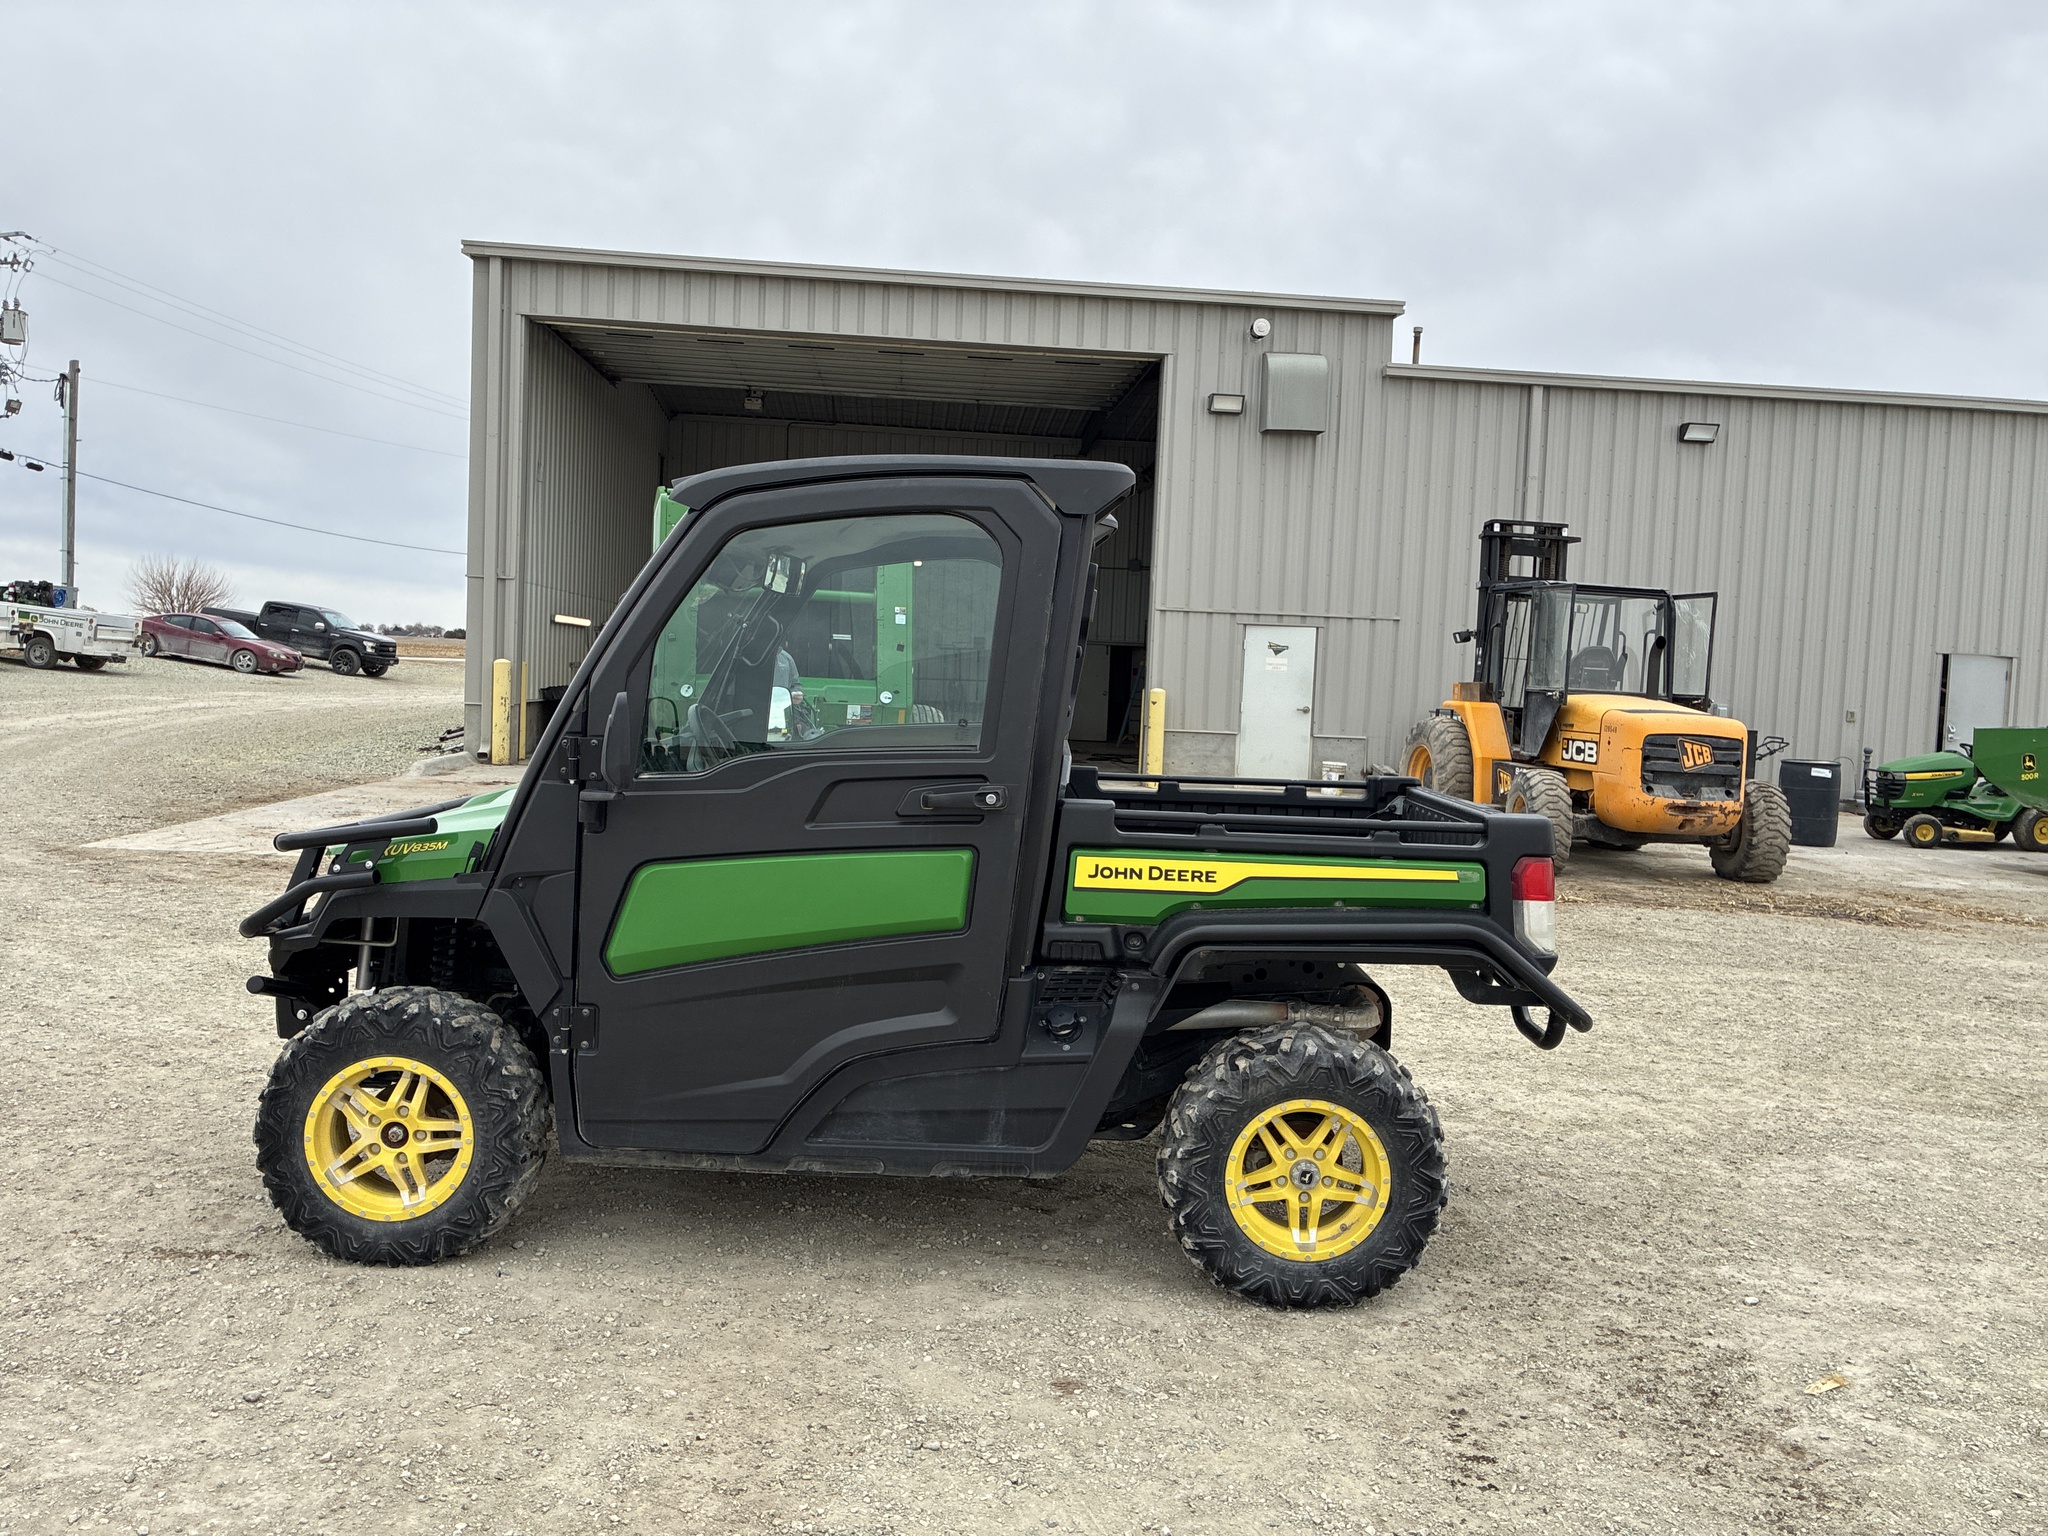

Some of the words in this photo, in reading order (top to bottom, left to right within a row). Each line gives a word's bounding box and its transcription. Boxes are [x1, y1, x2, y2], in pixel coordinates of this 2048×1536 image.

[39, 615, 59, 625] JOHN
[60, 620, 84, 629] DEERE
[1562, 740, 1597, 763] JCB
[1683, 742, 1712, 768] JCB
[1088, 863, 1143, 880] JOHN
[1148, 866, 1218, 883] DEERE
